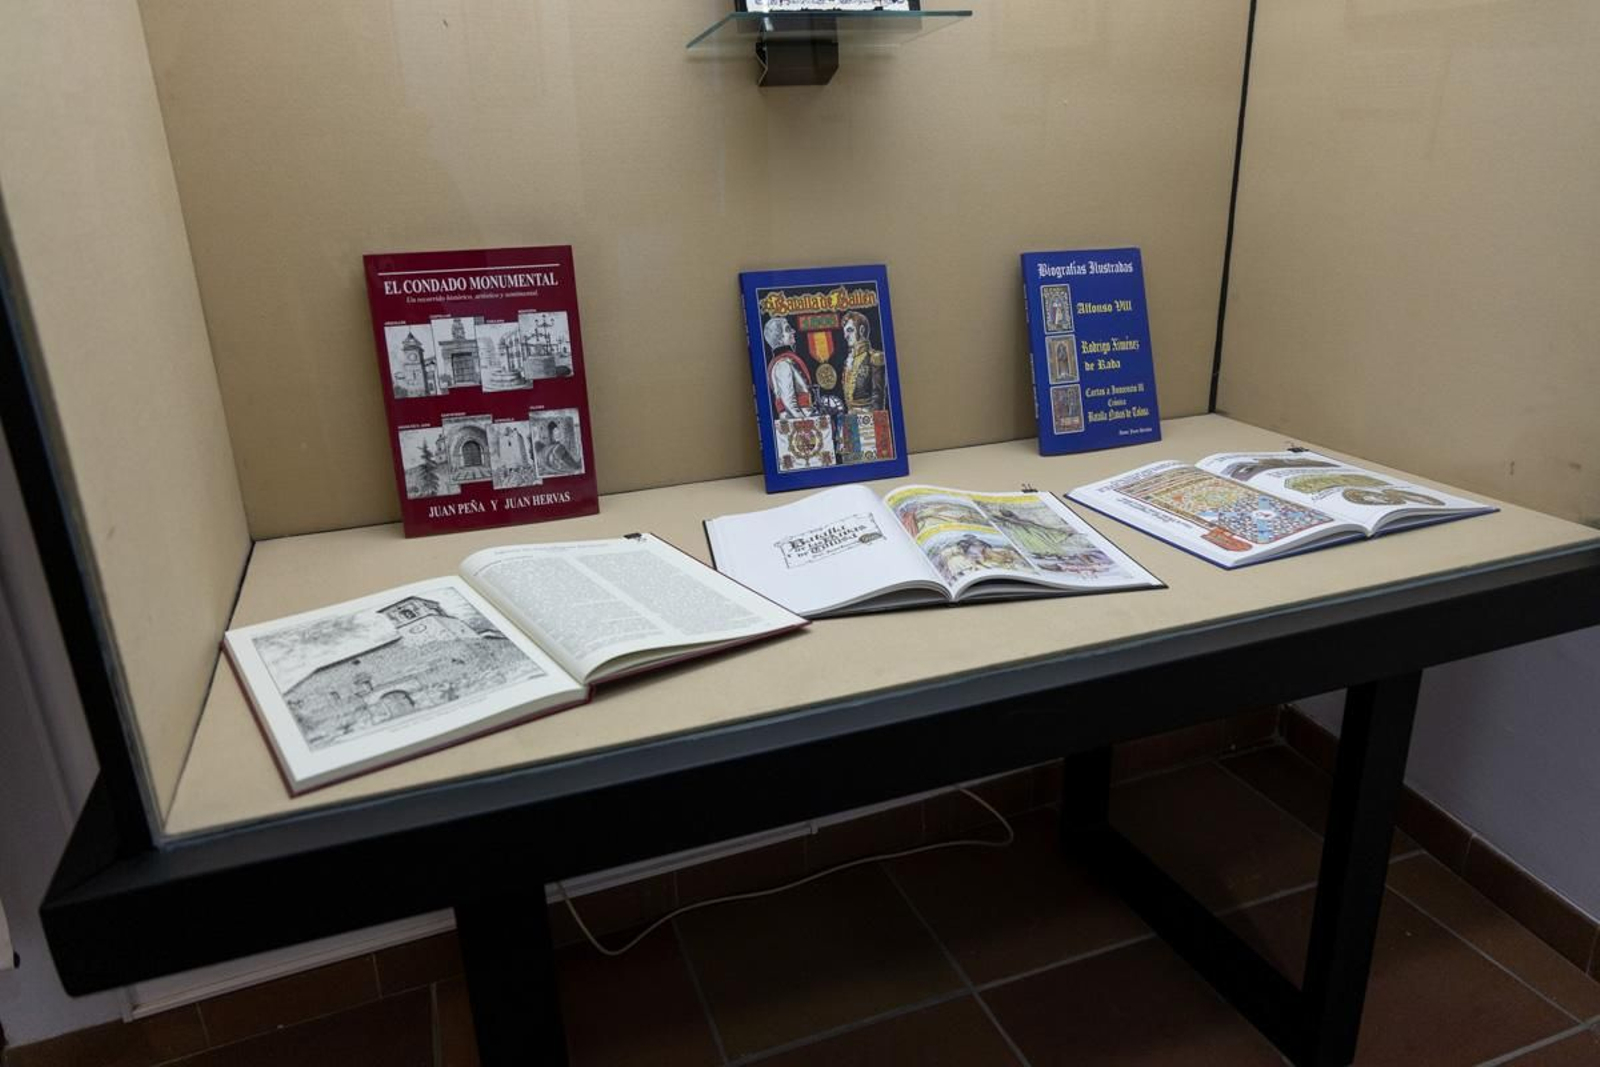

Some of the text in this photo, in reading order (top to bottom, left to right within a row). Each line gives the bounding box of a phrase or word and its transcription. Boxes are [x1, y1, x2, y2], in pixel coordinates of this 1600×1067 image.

[1037, 260, 1134, 278] Biografías Ilustradas
[384, 272, 559, 295] EL CONDADO MONUMENTAL
[1077, 302, 1113, 315] Alfonso
[1081, 339, 1111, 355] Rodrigo
[1084, 359, 1121, 371] de Rada
[428, 491, 571, 519] JUAN PEÑA Y JUAN HERVAS
